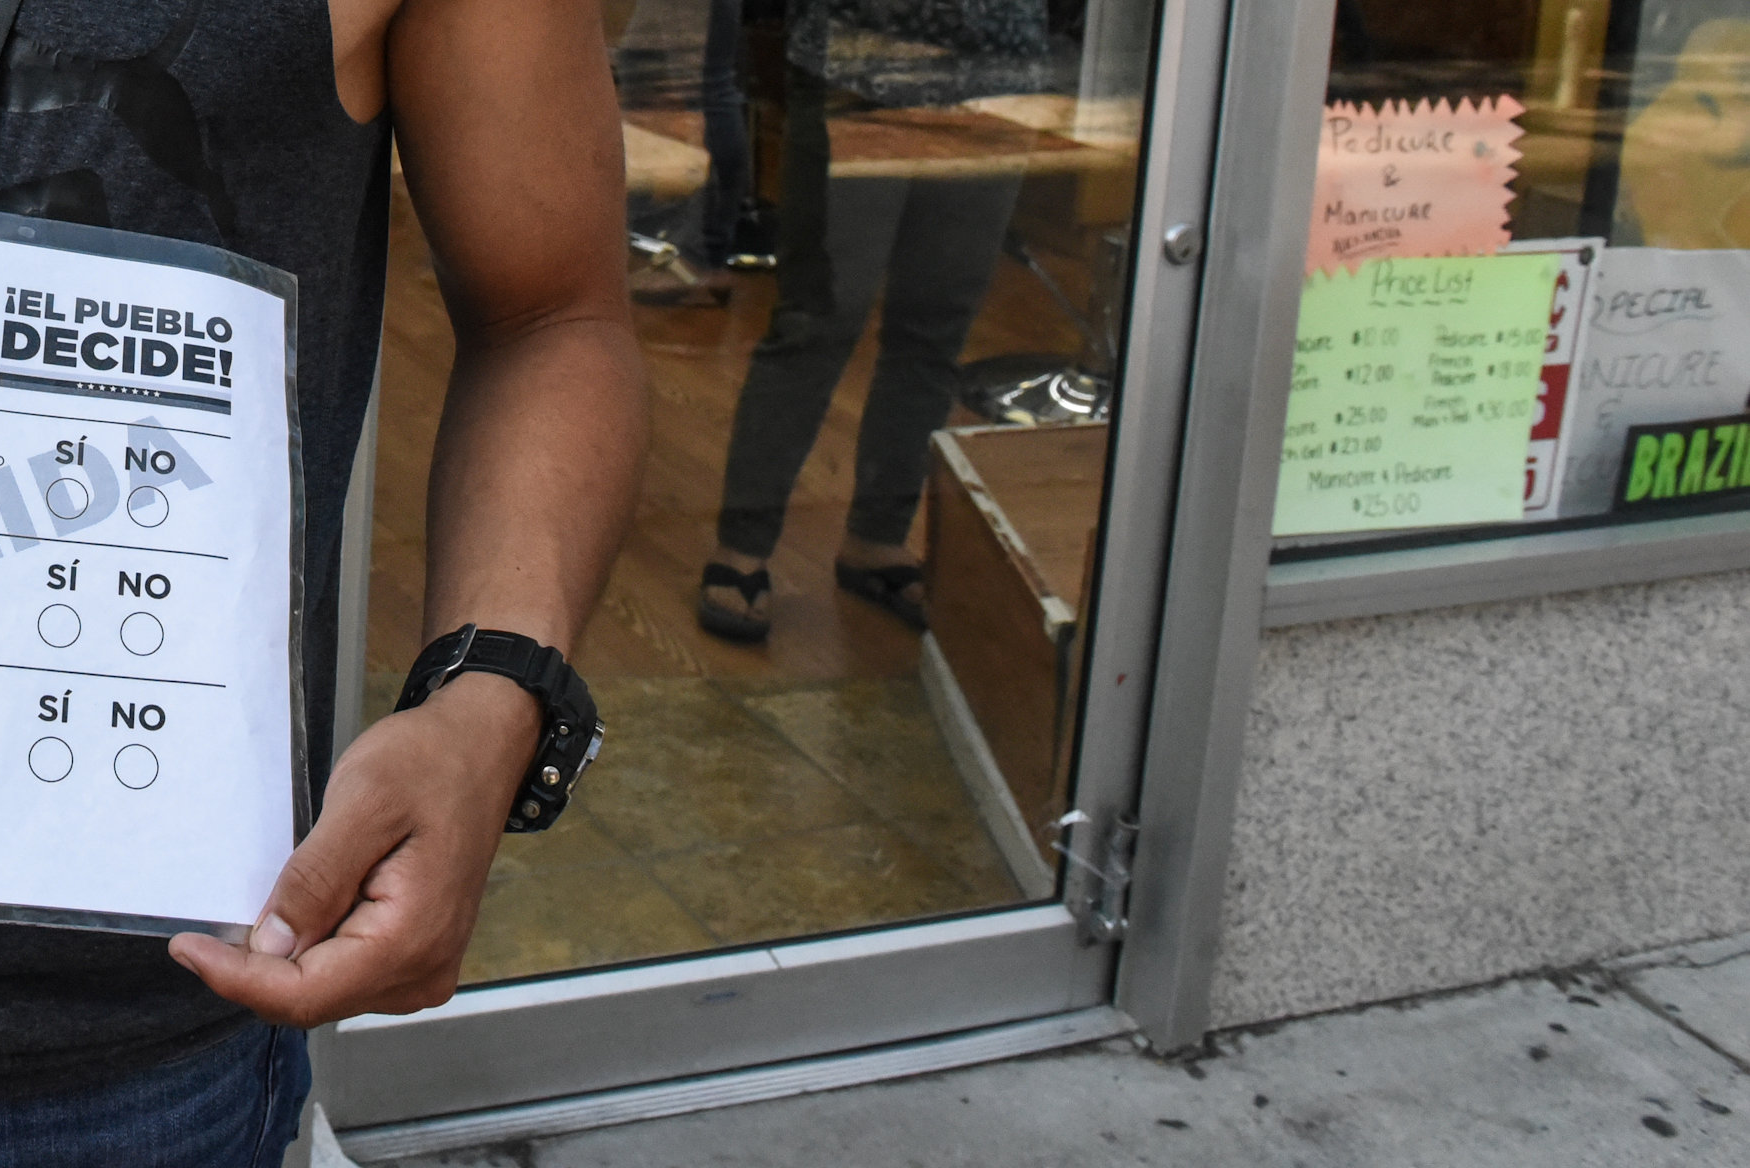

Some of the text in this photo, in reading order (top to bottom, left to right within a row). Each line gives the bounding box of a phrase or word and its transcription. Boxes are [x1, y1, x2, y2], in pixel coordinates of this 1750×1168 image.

[4, 286, 234, 345] ¡EL PUEBLO
[0, 319, 234, 390] DECIDE!
[54, 434, 177, 476] SÍ NO
[46, 558, 173, 601] SÍ NO
[37, 688, 167, 733] SÍ NO
